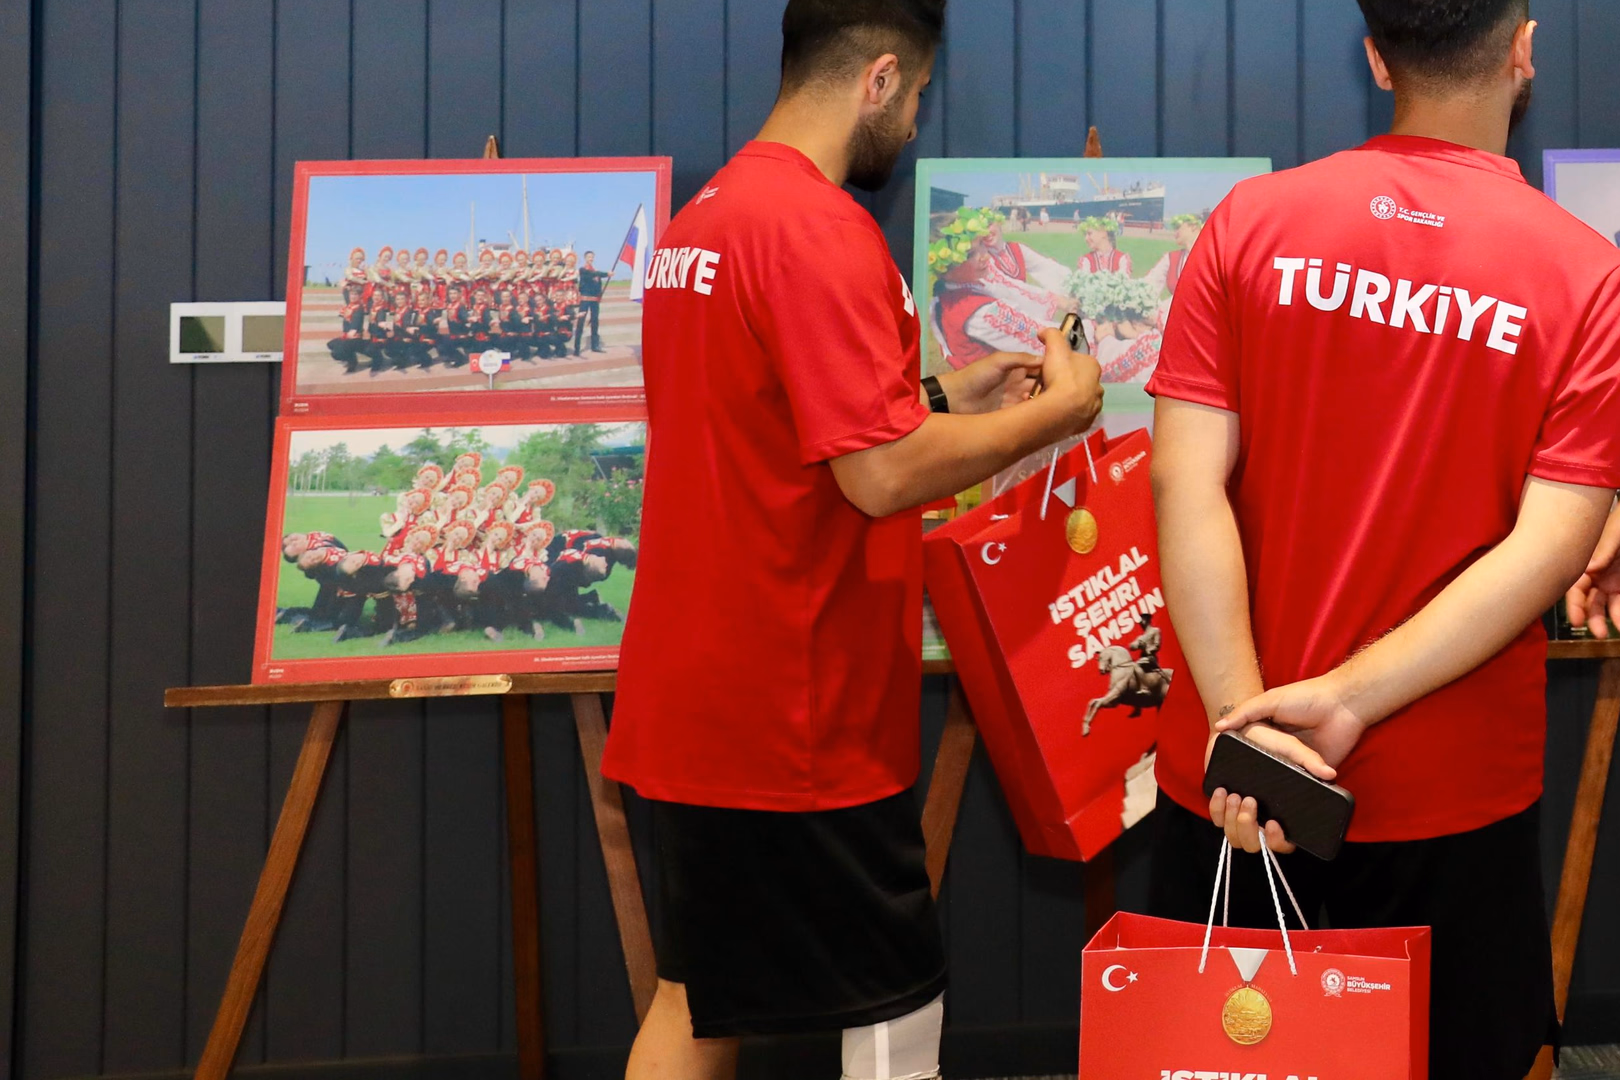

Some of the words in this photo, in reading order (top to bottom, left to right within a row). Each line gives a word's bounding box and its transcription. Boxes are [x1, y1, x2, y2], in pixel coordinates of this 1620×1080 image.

[645, 246, 721, 296] ÜRKİYE
[1273, 256, 1528, 355] TÜRKİYE
[1048, 546, 1149, 625] İSTİKLAL
[1073, 576, 1141, 638] ŞEHRİ
